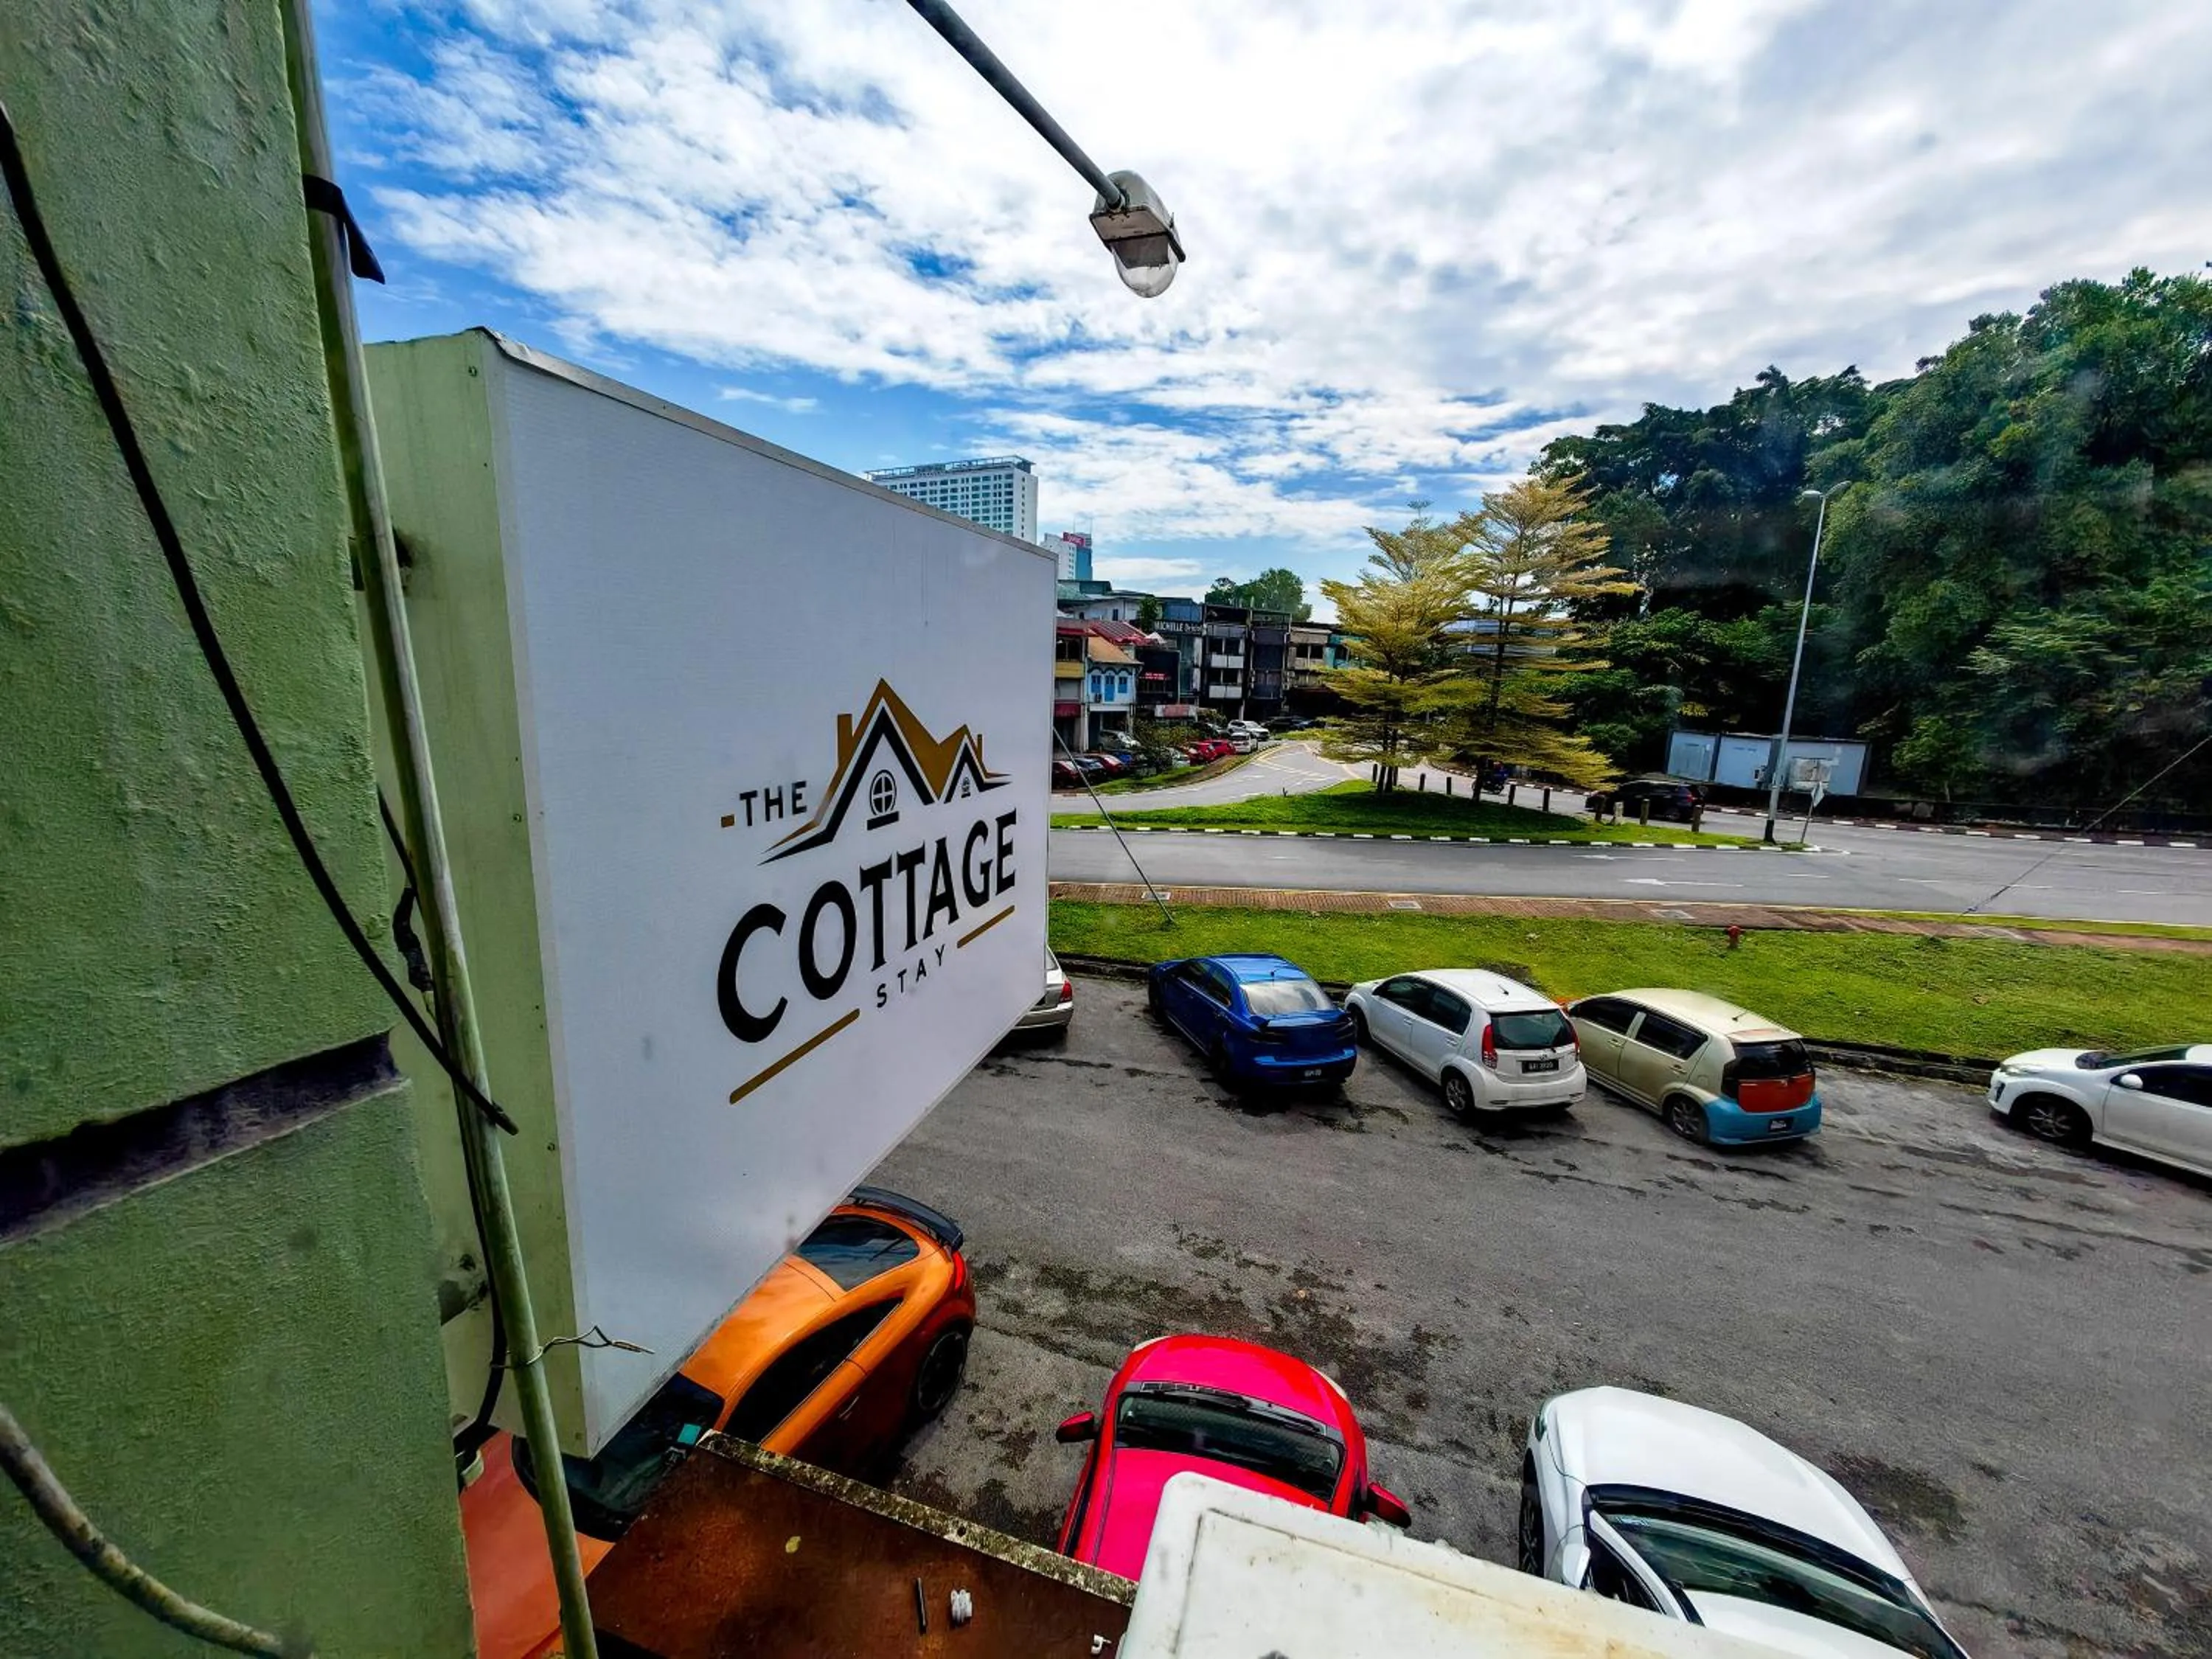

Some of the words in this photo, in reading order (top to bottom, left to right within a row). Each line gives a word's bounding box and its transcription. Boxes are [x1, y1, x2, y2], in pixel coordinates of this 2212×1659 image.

[739, 779, 808, 827] THE
[717, 807, 1018, 1043] COTTAGE
[877, 944, 946, 1008] STAY
